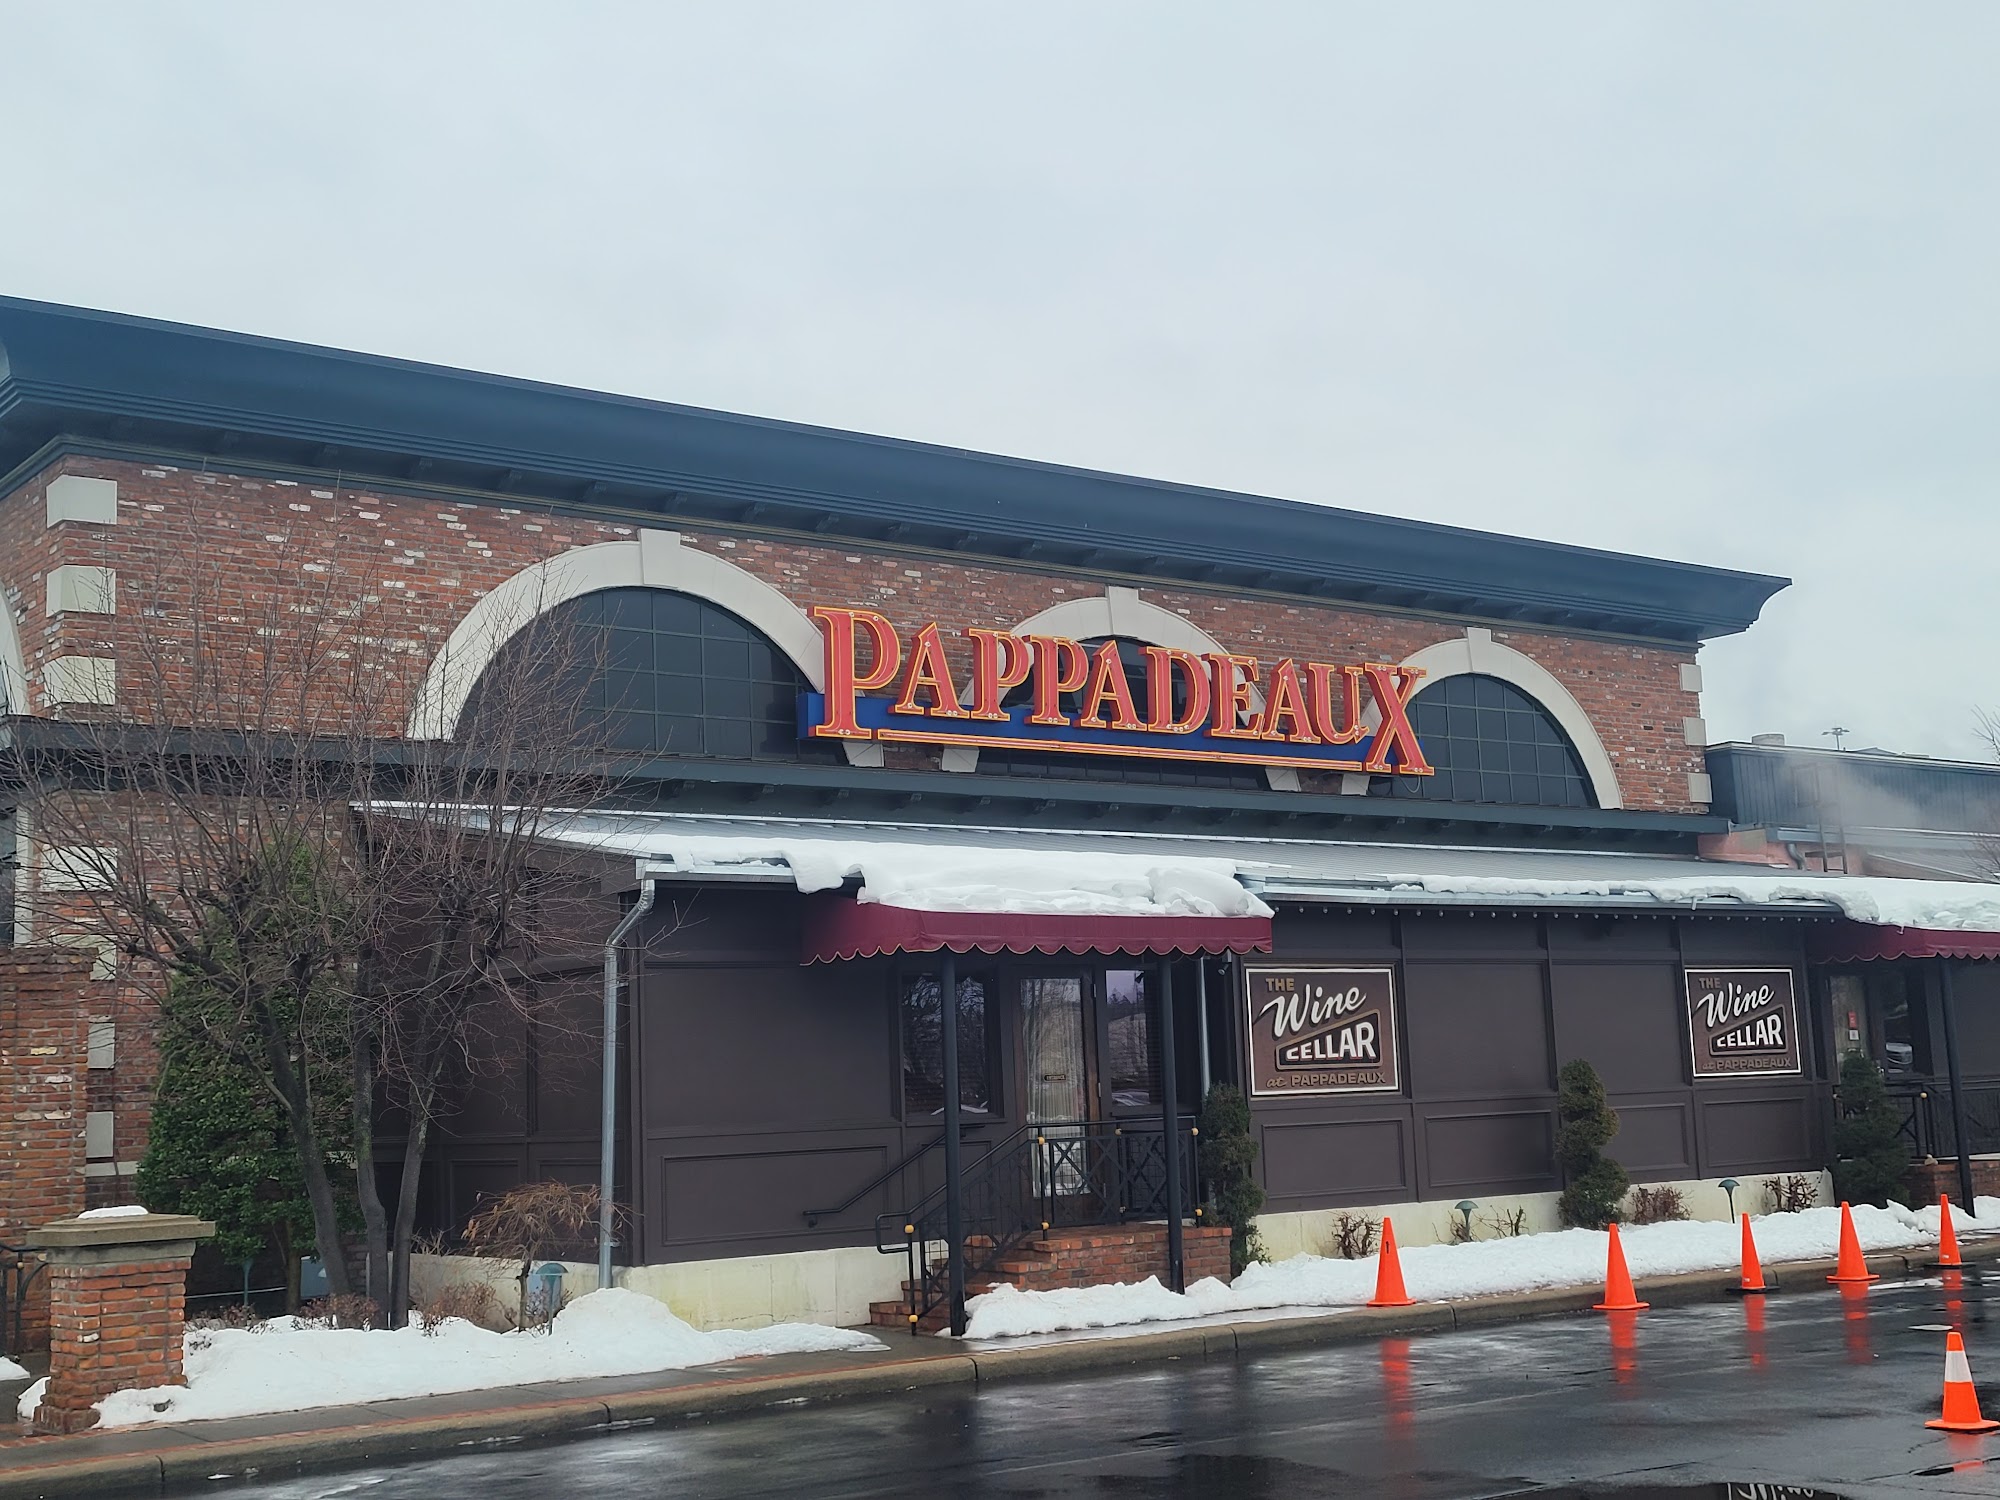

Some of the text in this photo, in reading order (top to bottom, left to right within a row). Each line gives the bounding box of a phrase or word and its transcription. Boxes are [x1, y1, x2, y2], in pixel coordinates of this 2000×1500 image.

[808, 605, 1435, 777] PAPPADEAUX
[1266, 978, 1295, 992] THE
[1699, 977, 1721, 989] THE
[1259, 984, 1367, 1037] Wine
[1695, 982, 1774, 1028] Wine
[1286, 1021, 1377, 1060] CELLAR
[1716, 1013, 1784, 1047] CELLAR
[1266, 1072, 1386, 1088] at PAPPADEAUX
[1716, 1058, 1792, 1070] PAPPADEAUX
